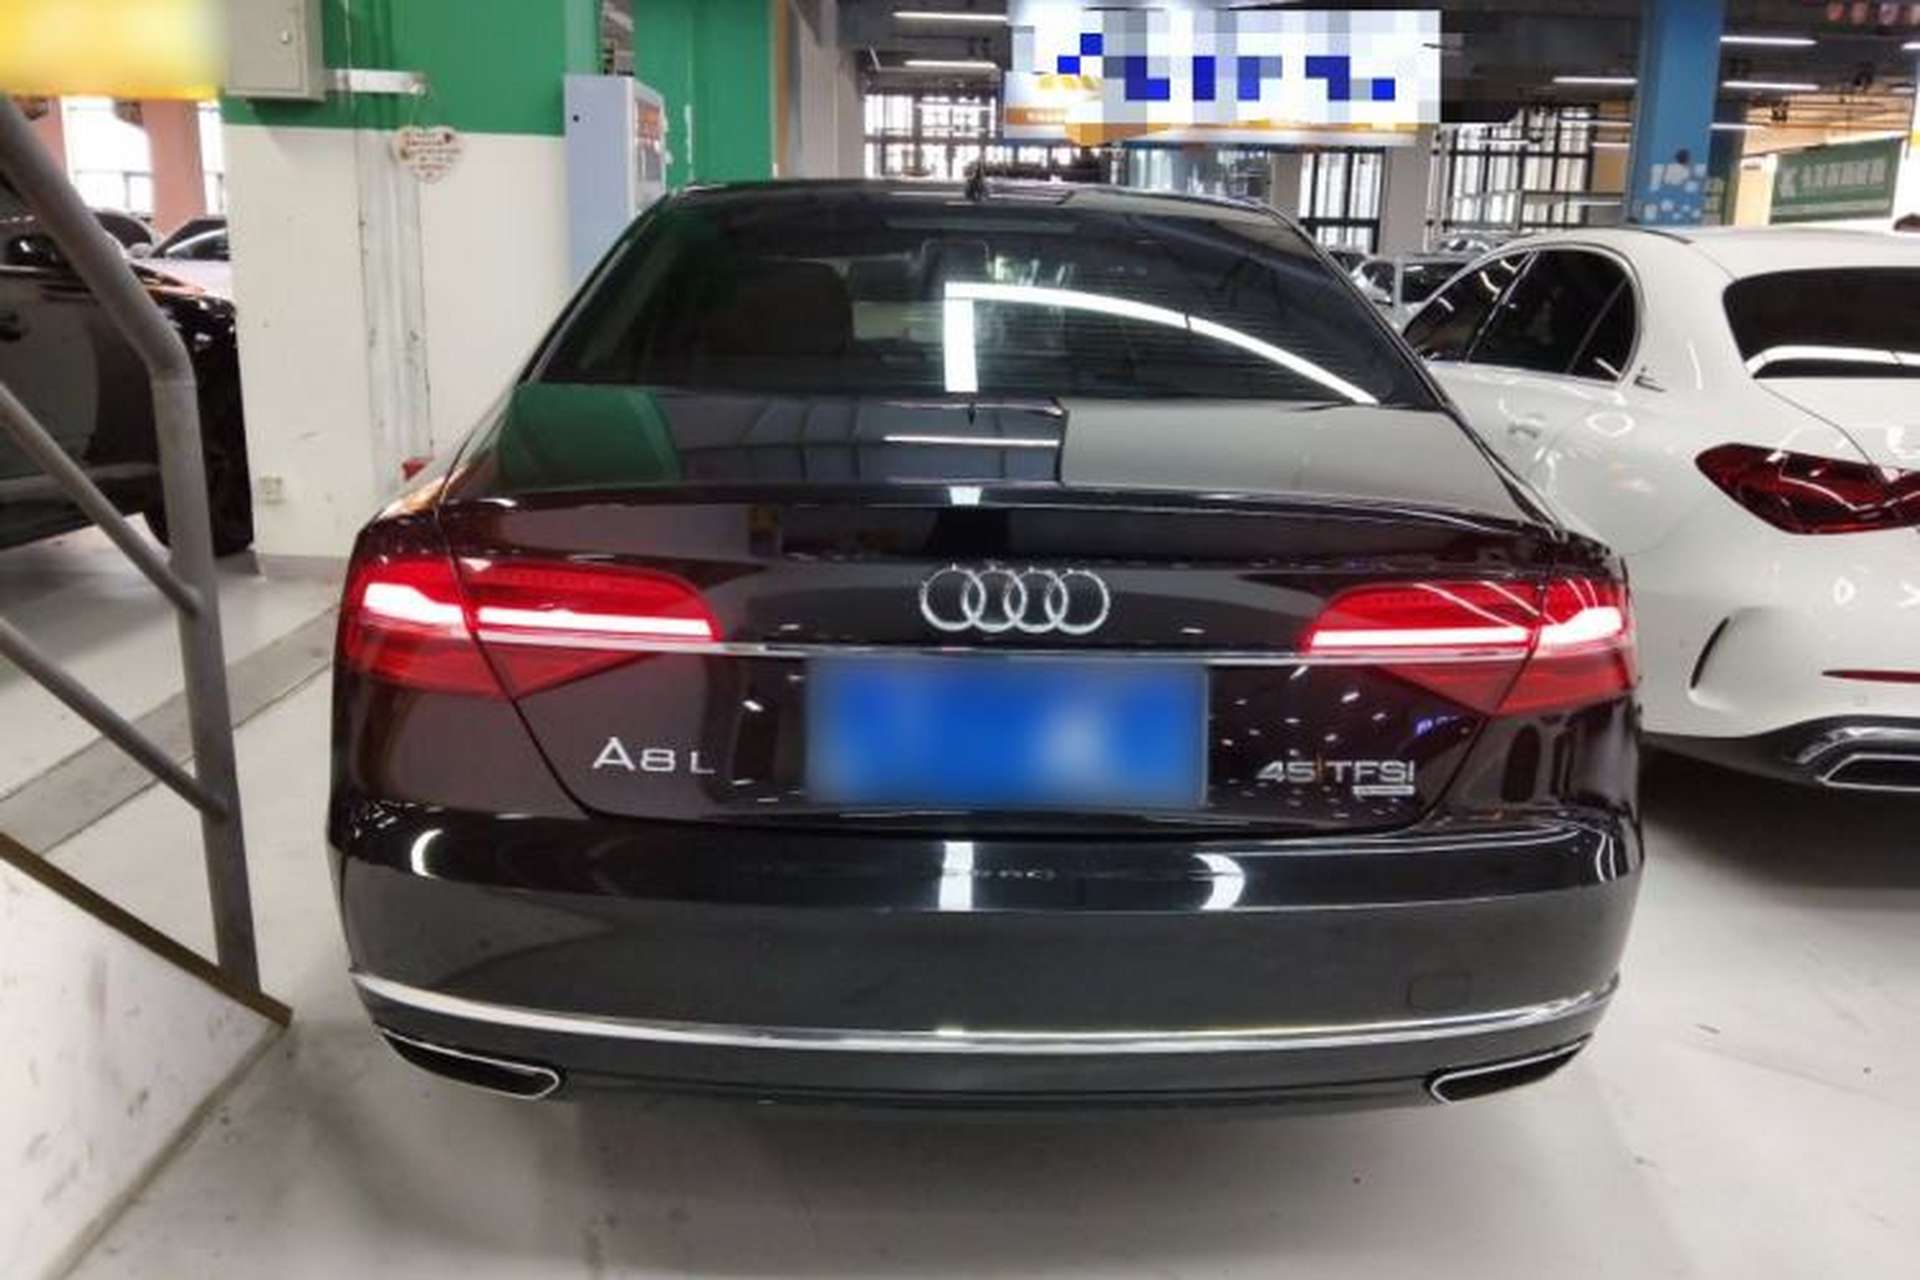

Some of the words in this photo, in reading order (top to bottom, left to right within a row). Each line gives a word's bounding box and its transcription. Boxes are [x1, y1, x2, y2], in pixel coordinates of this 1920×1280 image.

[592, 736, 676, 773] A8
[690, 751, 717, 774] L
[1256, 760, 1315, 783] 45
[1325, 759, 1415, 783] TFSI
